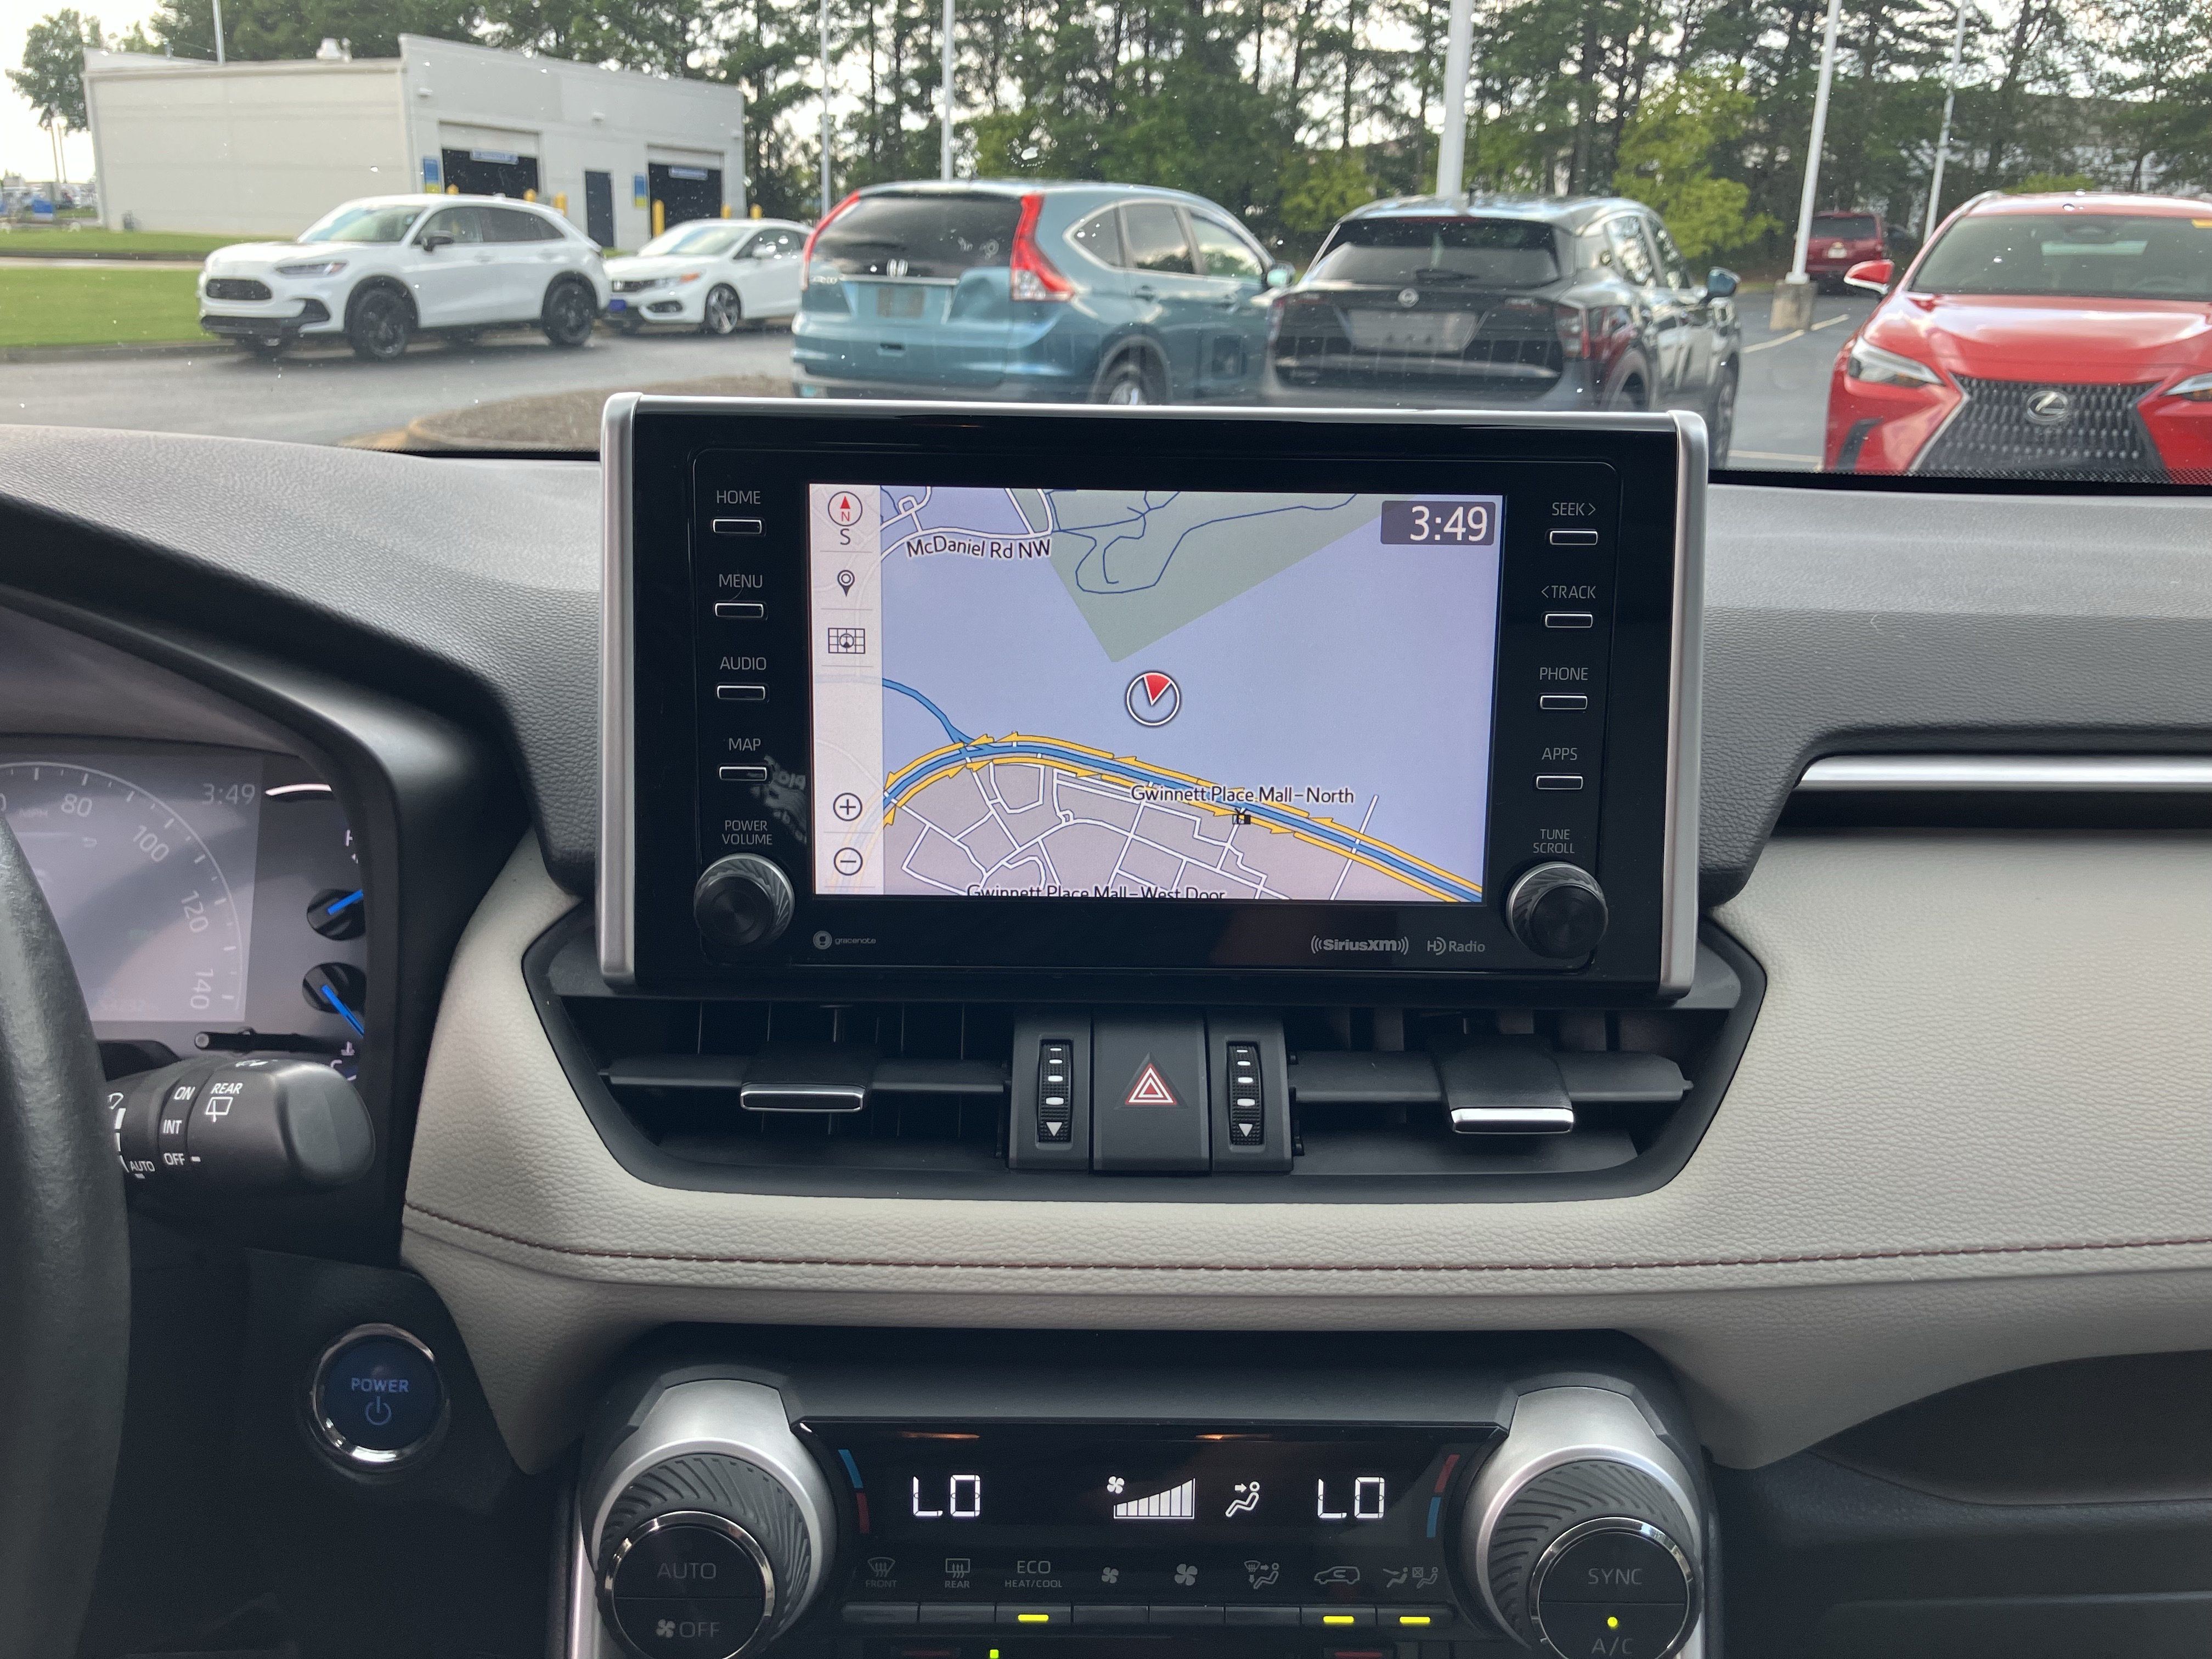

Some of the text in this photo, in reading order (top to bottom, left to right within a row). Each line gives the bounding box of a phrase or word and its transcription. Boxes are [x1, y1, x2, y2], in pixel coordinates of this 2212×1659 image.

[716, 490, 761, 504] HOME
[841, 511, 850, 522] N
[1410, 505, 1487, 541] 3:49
[840, 528, 851, 545] S
[906, 535, 1051, 558] McDaniel Rd NW
[719, 574, 763, 588] MENU
[720, 657, 766, 670] AUDIO
[1539, 667, 1589, 680] PHONE
[729, 738, 761, 752] MAP
[1542, 748, 1577, 760] APPS
[202, 783, 256, 804] 3:49
[1131, 785, 1206, 802] Gwinnett
[1212, 786, 1254, 802] Place
[61, 793, 92, 817] 80
[725, 820, 768, 831] POWER
[722, 834, 772, 845] VOLUME
[1540, 829, 1570, 840] TUNE
[133, 825, 169, 862] 100
[1533, 843, 1575, 854] SCROLL
[180, 890, 208, 932] 120
[1449, 940, 1486, 952] Radio
[190, 968, 214, 1009] 140
[174, 1086, 196, 1101] ON
[211, 1082, 243, 1094] REAR
[163, 1119, 182, 1135] INT
[129, 1160, 155, 1172] AUTO
[165, 1153, 185, 1166] OFF
[351, 1378, 409, 1393] POWER
[913, 1475, 980, 1517] LO
[1318, 1477, 1385, 1519] LO
[658, 1562, 716, 1579] AUTO
[1017, 1561, 1051, 1574] ECO
[1005, 1579, 1063, 1588] HEAT/COOL
[1588, 1568, 1643, 1585] SYNC
[865, 1580, 897, 1588] FRONT
[679, 1622, 719, 1638] OFF
[1591, 1638, 1633, 1655] A/C
